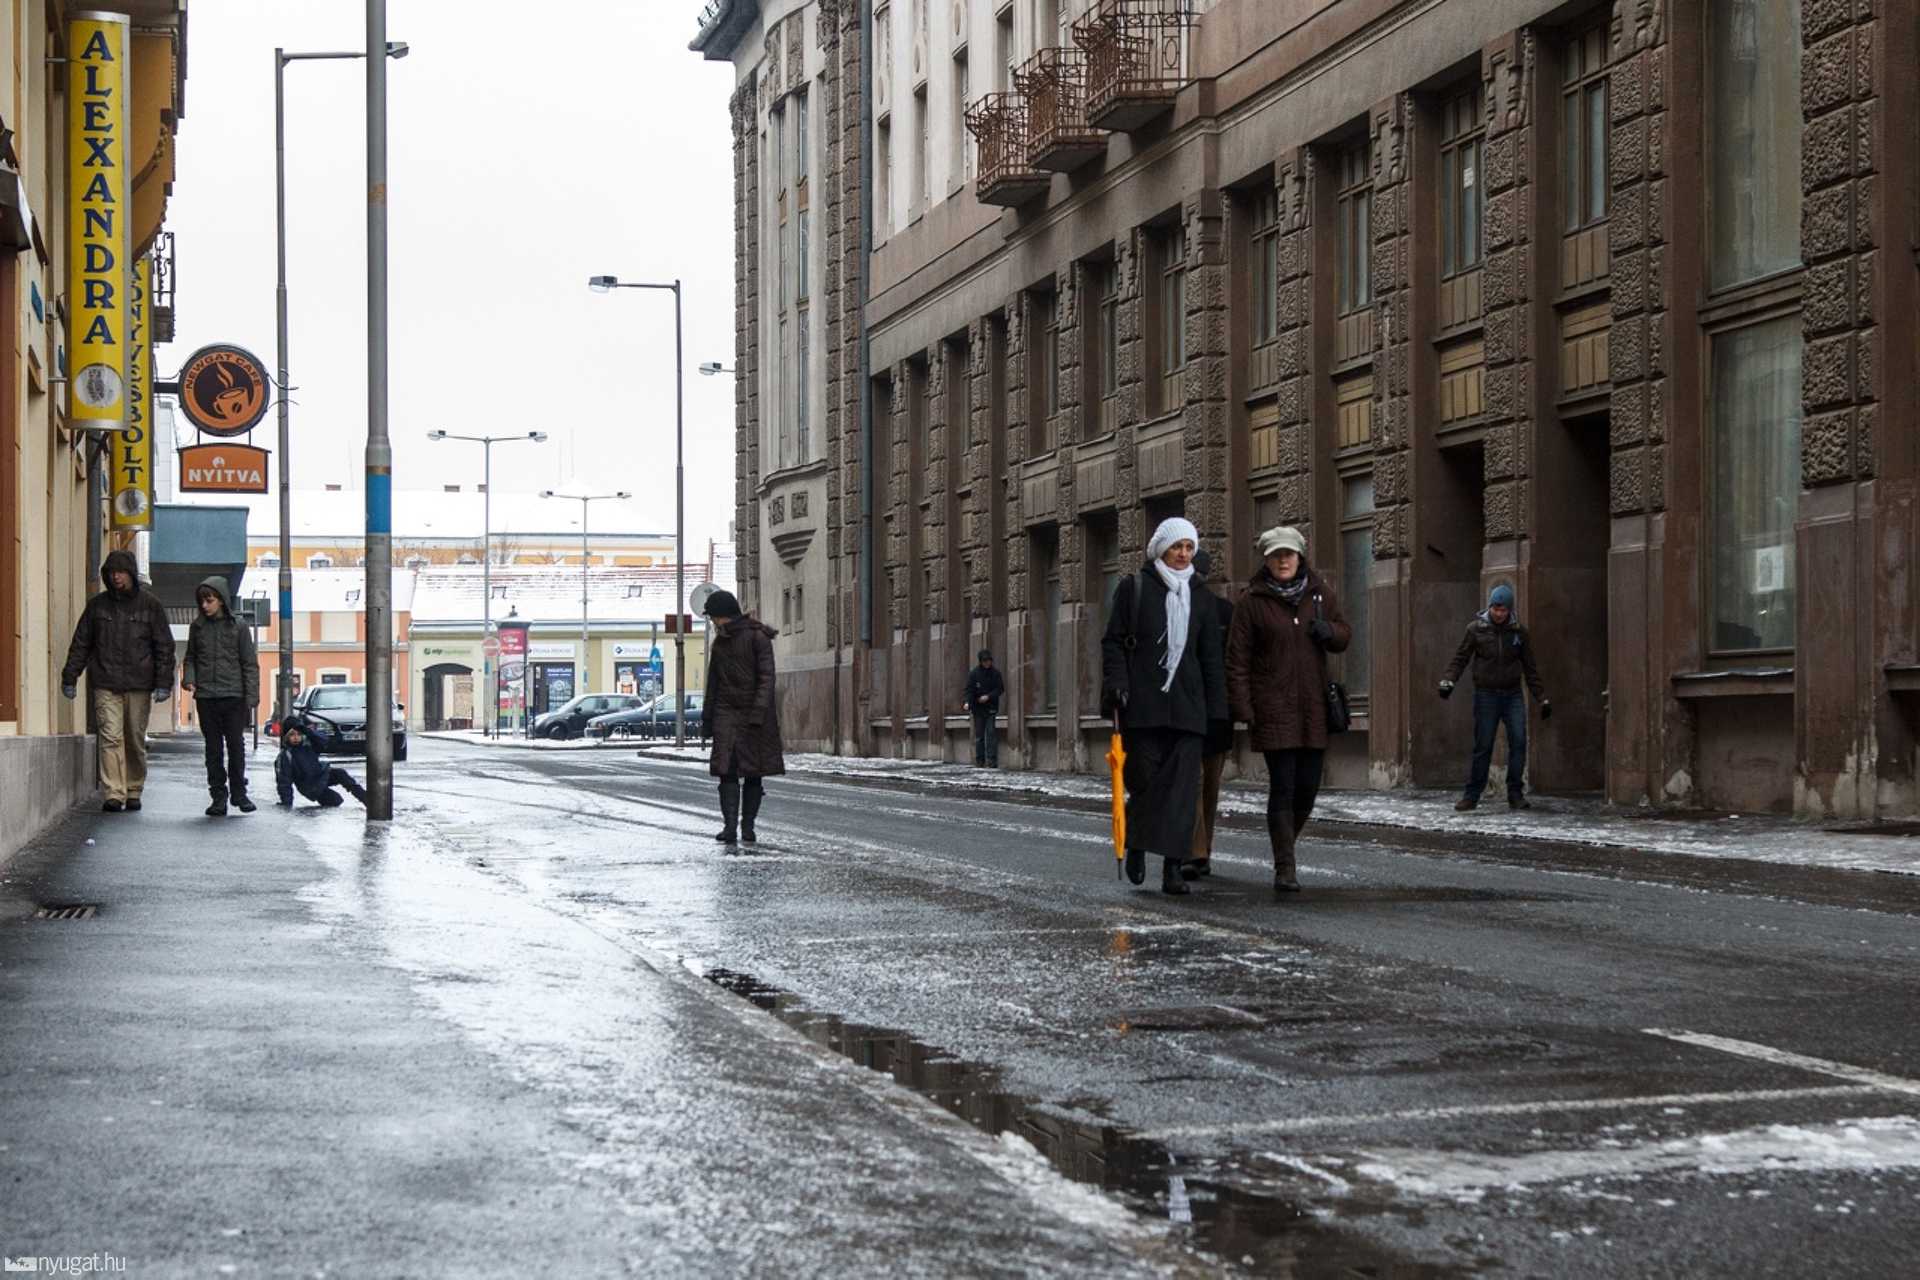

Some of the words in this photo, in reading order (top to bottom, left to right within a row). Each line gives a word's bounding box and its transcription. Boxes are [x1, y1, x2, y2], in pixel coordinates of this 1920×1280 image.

[80, 30, 116, 345] ALEXANDRA
[185, 353, 232, 390] NEWGAT
[188, 469, 262, 483] NYITVA
